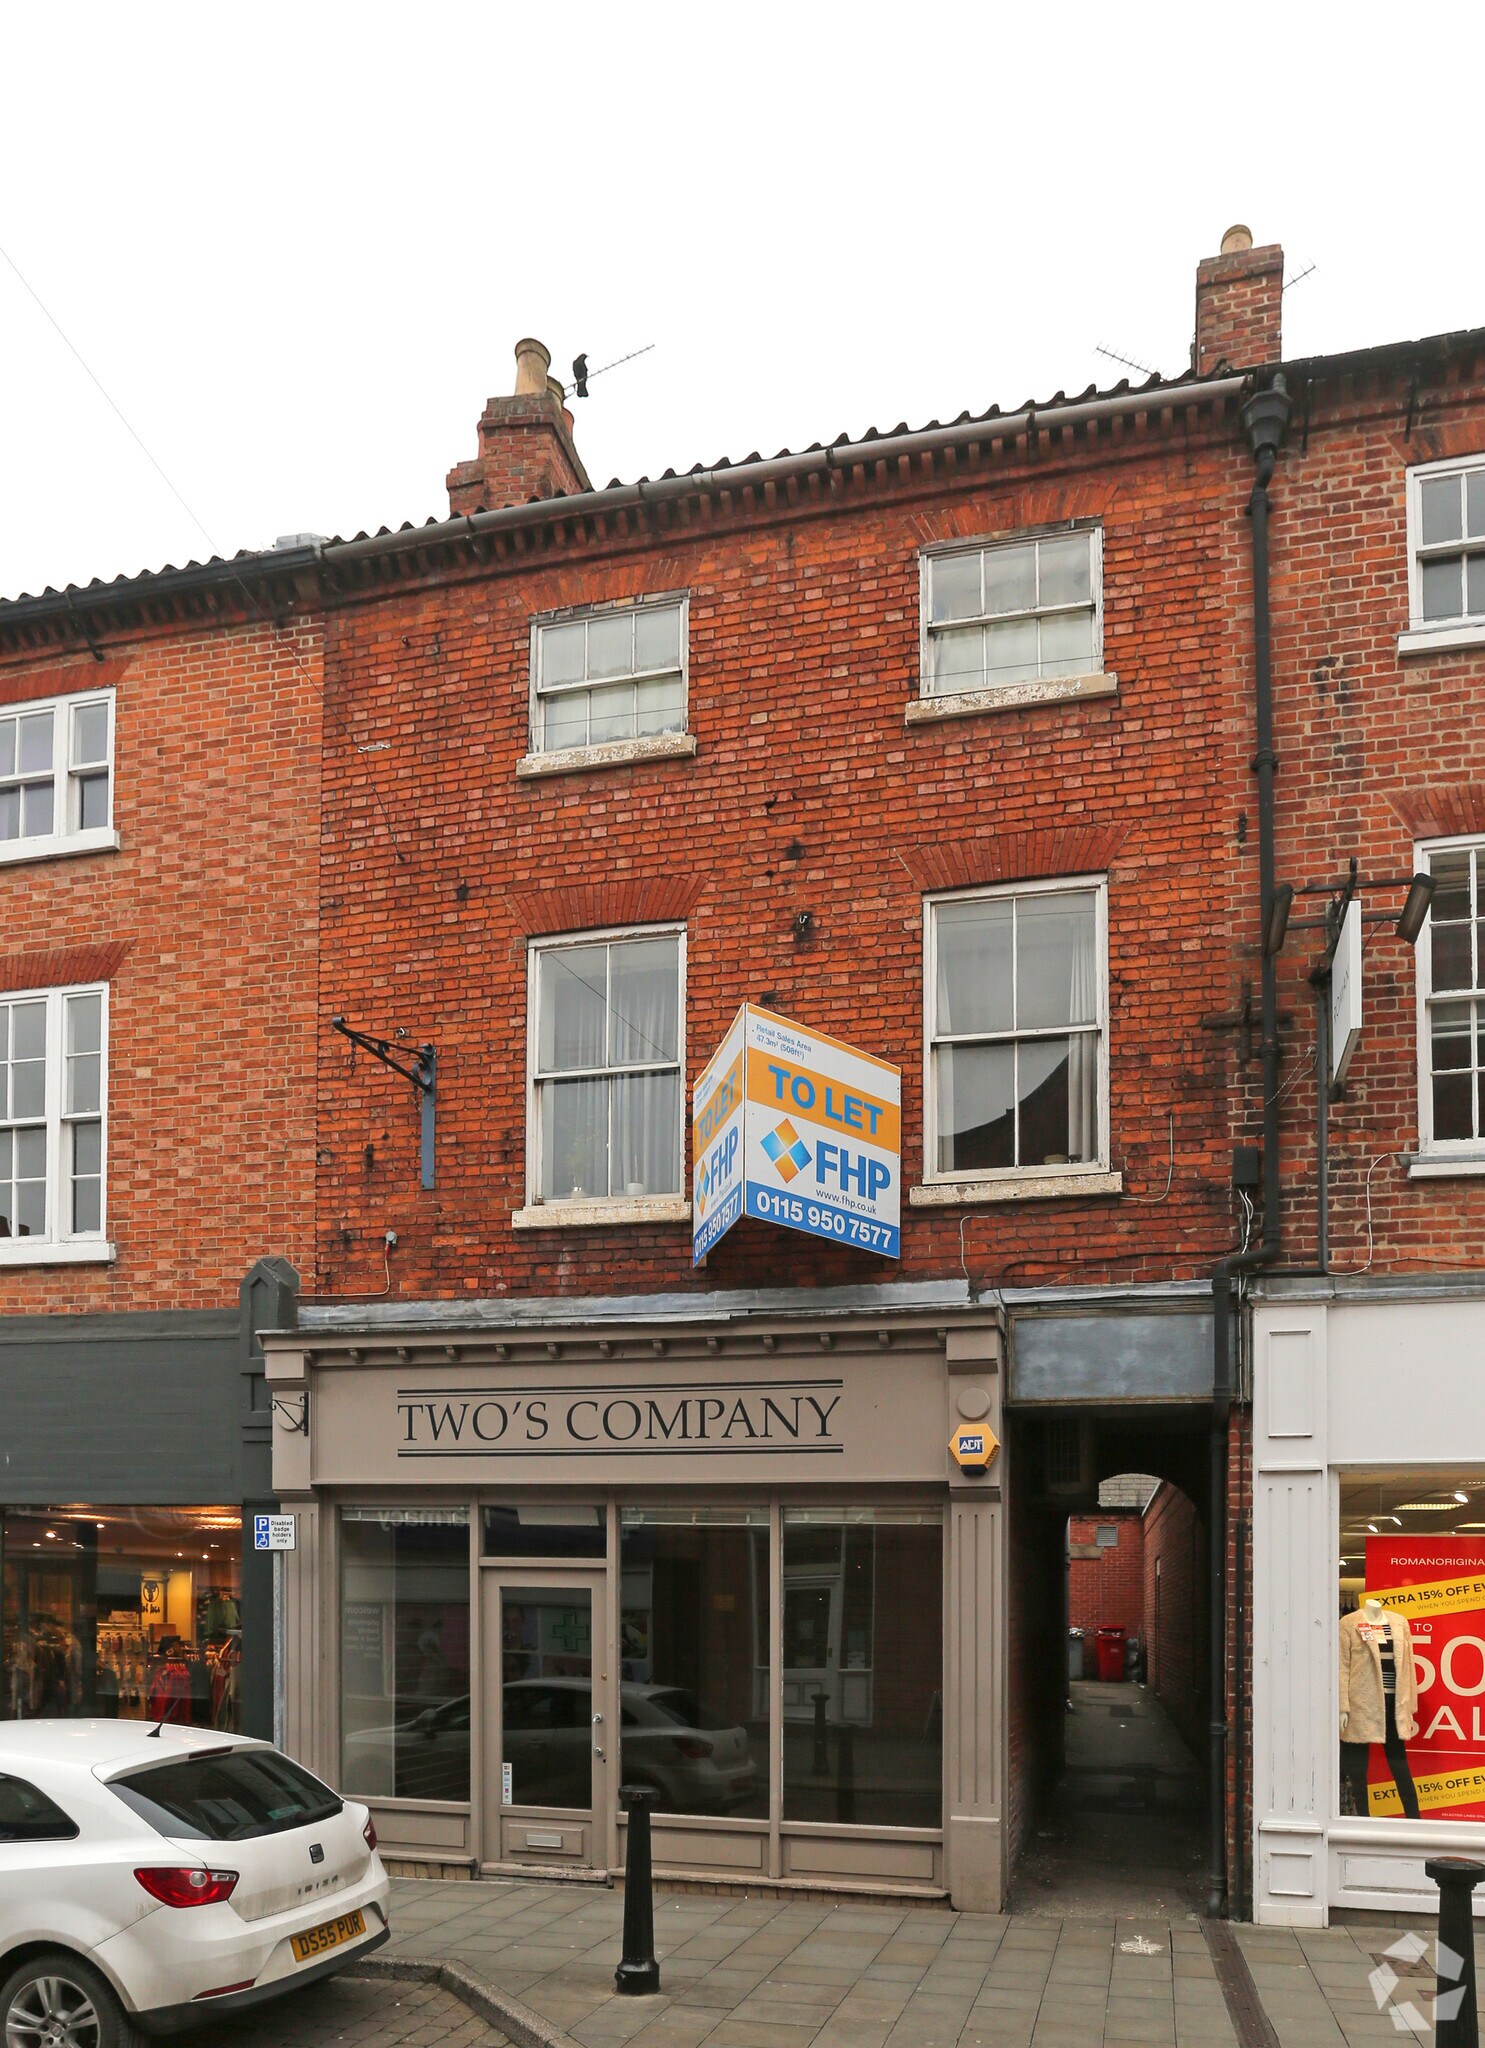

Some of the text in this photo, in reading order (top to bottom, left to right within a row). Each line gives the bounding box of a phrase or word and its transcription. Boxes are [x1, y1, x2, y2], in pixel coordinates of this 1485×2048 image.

[756, 1024, 812, 1052] Retail Sales Area
[699, 1108, 713, 1147] TO
[714, 1071, 736, 1126] LET
[768, 1064, 816, 1109] TO
[825, 1086, 883, 1135] LET
[711, 1126, 738, 1197] FHP
[816, 1140, 891, 1201] FHP
[815, 1189, 877, 1215] www.fhp.co.uk
[694, 1227, 708, 1257] 0115
[708, 1213, 721, 1242] 950
[721, 1192, 739, 1227] 7577
[756, 1191, 804, 1222] 0115
[807, 1206, 846, 1235] 950
[848, 1218, 892, 1248] 7577
[397, 1395, 842, 1441] TWO'S COMPANY
[960, 1440, 983, 1451] ADT
[258, 1518, 268, 1531] P
[1417, 1602, 1439, 1610] WHEN
[1457, 1596, 1480, 1605] SPEND
[1418, 1589, 1443, 1601] 15%
[1445, 1584, 1470, 1597] OFF
[1413, 1622, 1433, 1632] TO
[1373, 1788, 1397, 1800] EXT
[1417, 1782, 1443, 1793] 15%
[1445, 1777, 1470, 1789] OFF
[1457, 1789, 1481, 1797] SPEND
[298, 1914, 362, 1956] DS55 PUR
